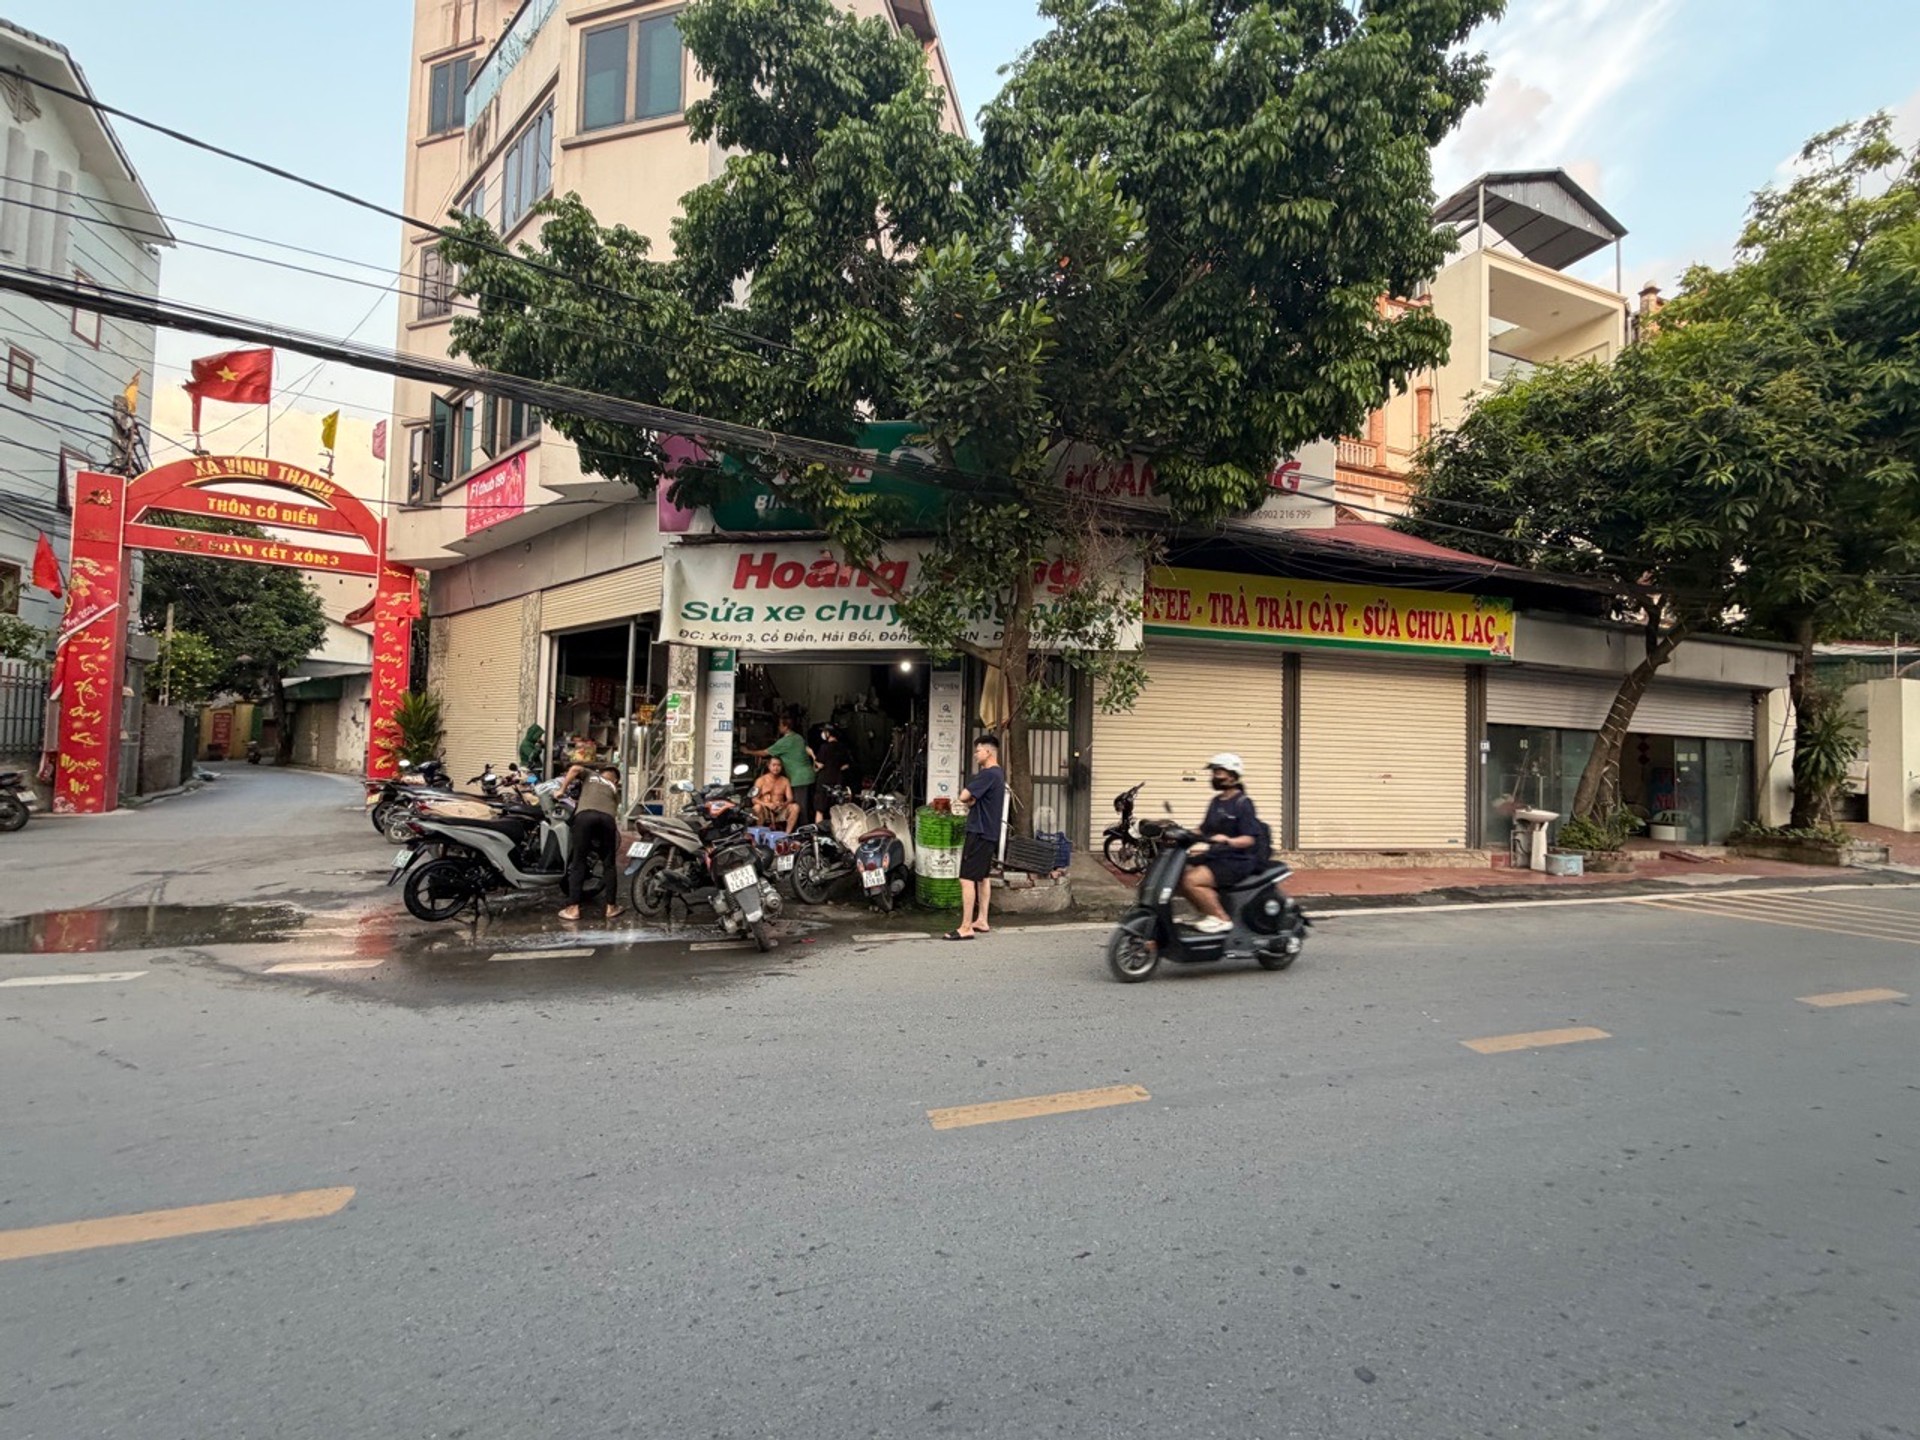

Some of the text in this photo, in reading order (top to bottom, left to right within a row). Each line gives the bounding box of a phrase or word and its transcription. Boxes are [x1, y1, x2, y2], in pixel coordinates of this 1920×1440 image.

[278, 465, 335, 499] THANH
[207, 497, 318, 526] THÔN CỔ ĐIỂN
[1280, 510, 1294, 519] 216
[1296, 510, 1311, 519] 799
[330, 554, 339, 566] 3
[733, 551, 909, 597] Hoàng
[681, 597, 754, 623] Sửa
[763, 604, 806, 622] xe
[1208, 585, 1249, 626] TRÀ
[1255, 590, 1303, 630] TRÁI
[1308, 592, 1348, 633] CÂY
[1363, 599, 1400, 637] SỮA
[1406, 609, 1456, 642] CHUA
[679, 628, 705, 640] ĐC:
[709, 631, 742, 643] Xóm
[746, 632, 756, 643] 3,
[761, 628, 779, 643] Cổ
[784, 628, 818, 643] Điển,
[821, 630, 844, 643] Hải
[848, 628, 875, 643] Bối,
